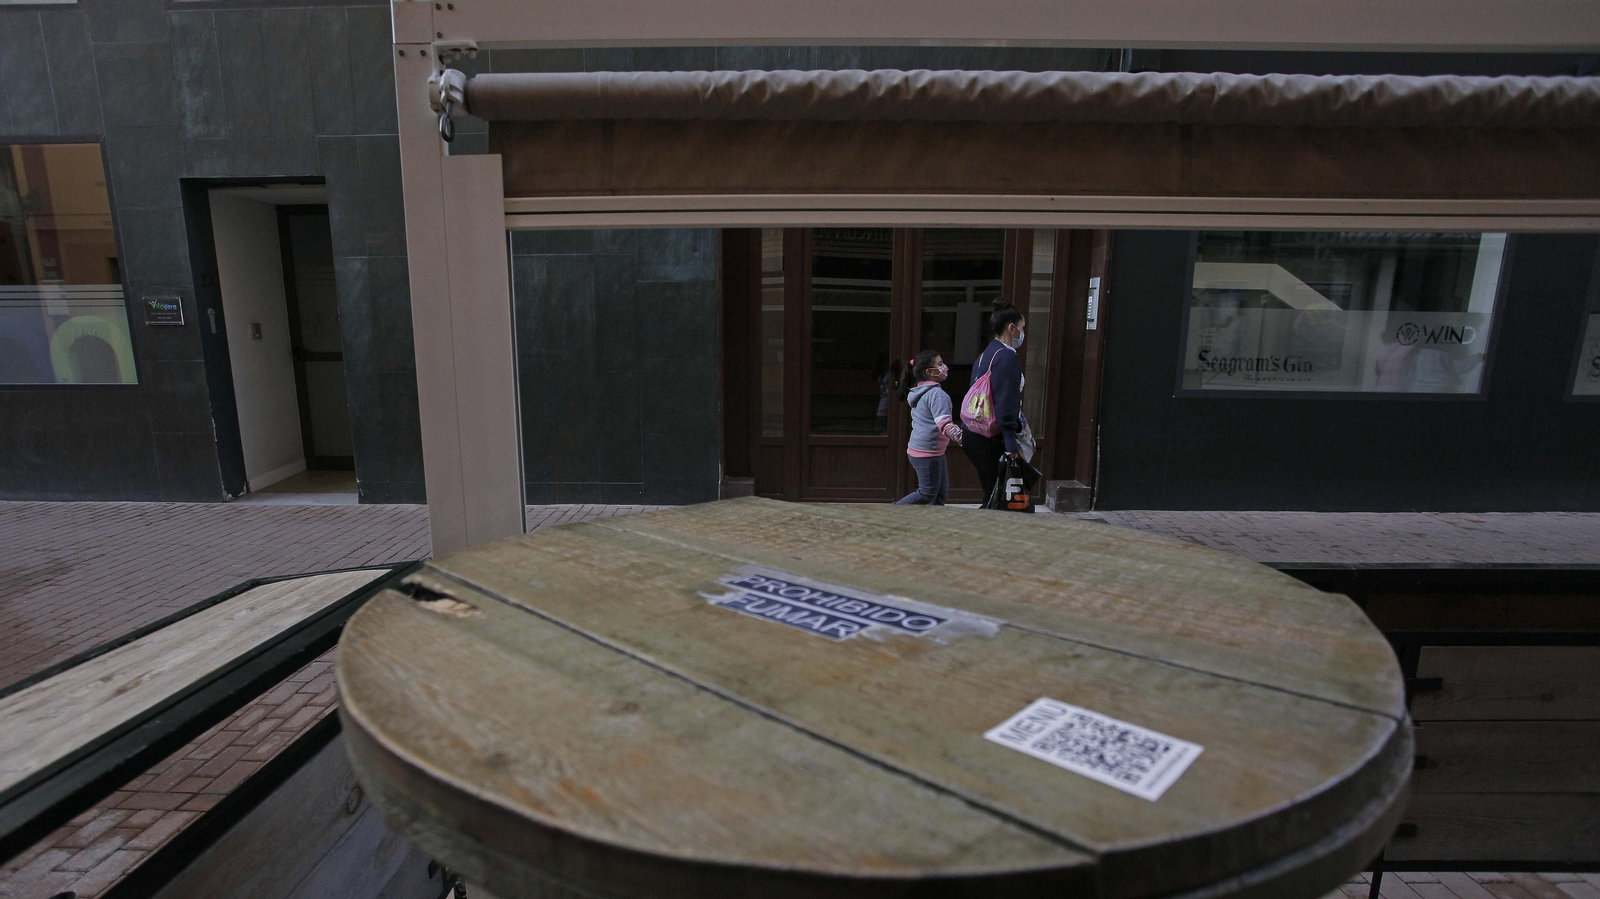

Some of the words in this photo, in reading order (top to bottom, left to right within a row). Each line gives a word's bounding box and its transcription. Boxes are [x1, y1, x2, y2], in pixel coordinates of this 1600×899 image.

[1422, 325, 1477, 345] WIND
[1195, 349, 1281, 376] Seagram's
[1283, 355, 1314, 374] Gin
[725, 594, 862, 638] FUMAR
[729, 575, 938, 631] PROHIBIDO
[998, 703, 1067, 744] MENU
